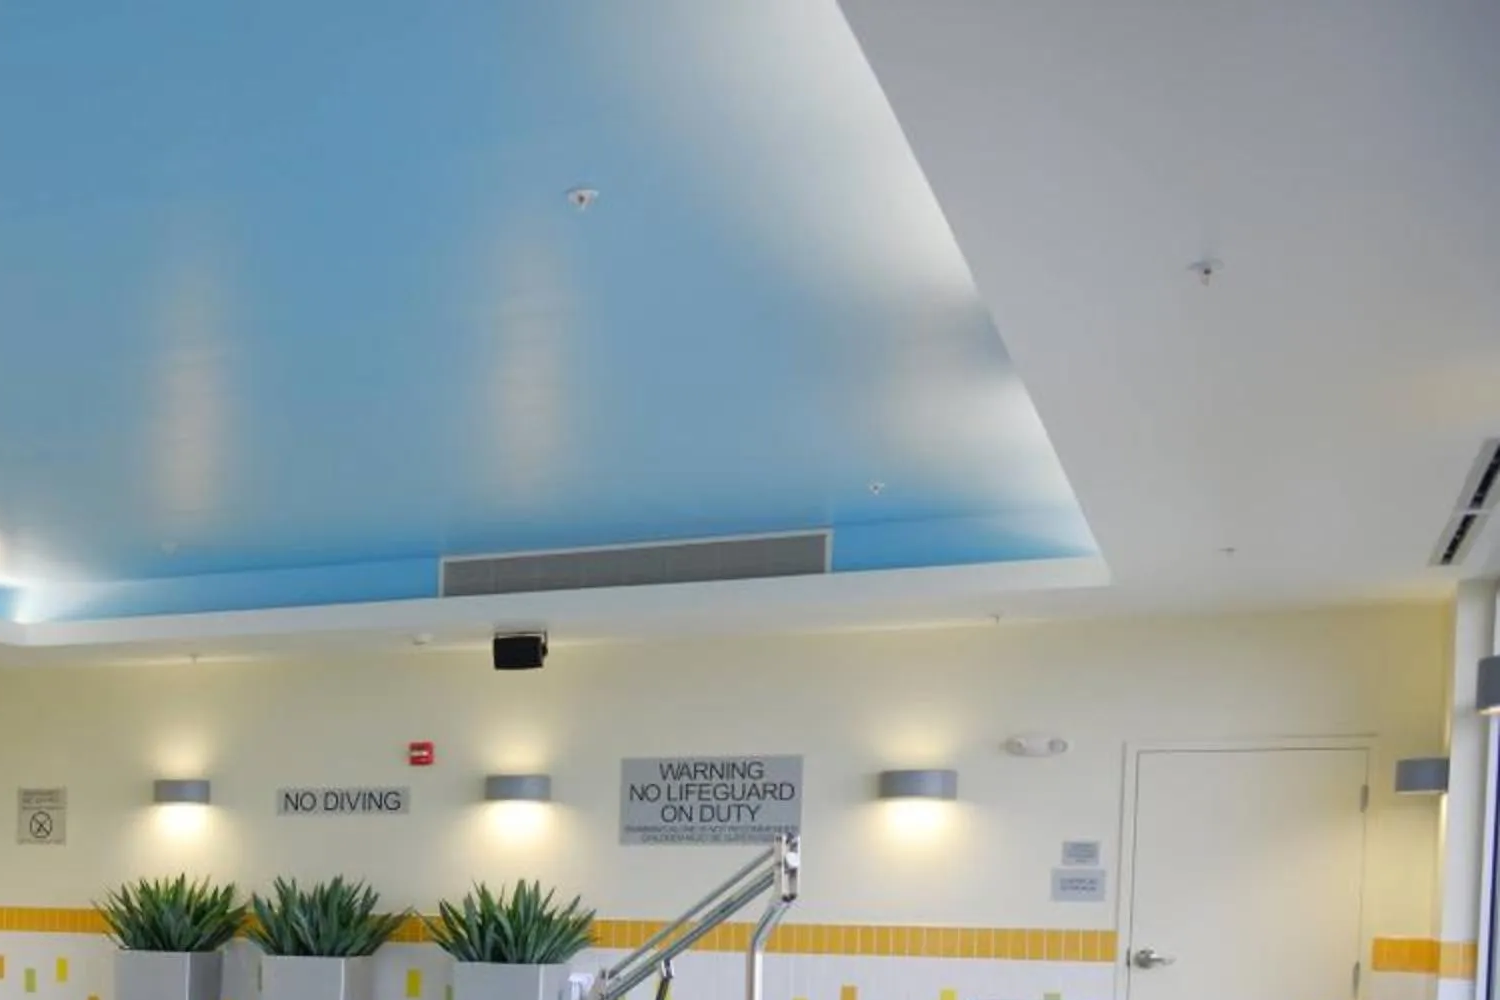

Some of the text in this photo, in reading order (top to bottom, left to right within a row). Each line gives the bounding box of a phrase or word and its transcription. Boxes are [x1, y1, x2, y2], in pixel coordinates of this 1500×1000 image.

[659, 761, 764, 781] WARNING
[284, 791, 401, 811] NO DIVING
[629, 782, 795, 803] NO LIFEGUARD
[660, 803, 761, 823] ON DUTY
